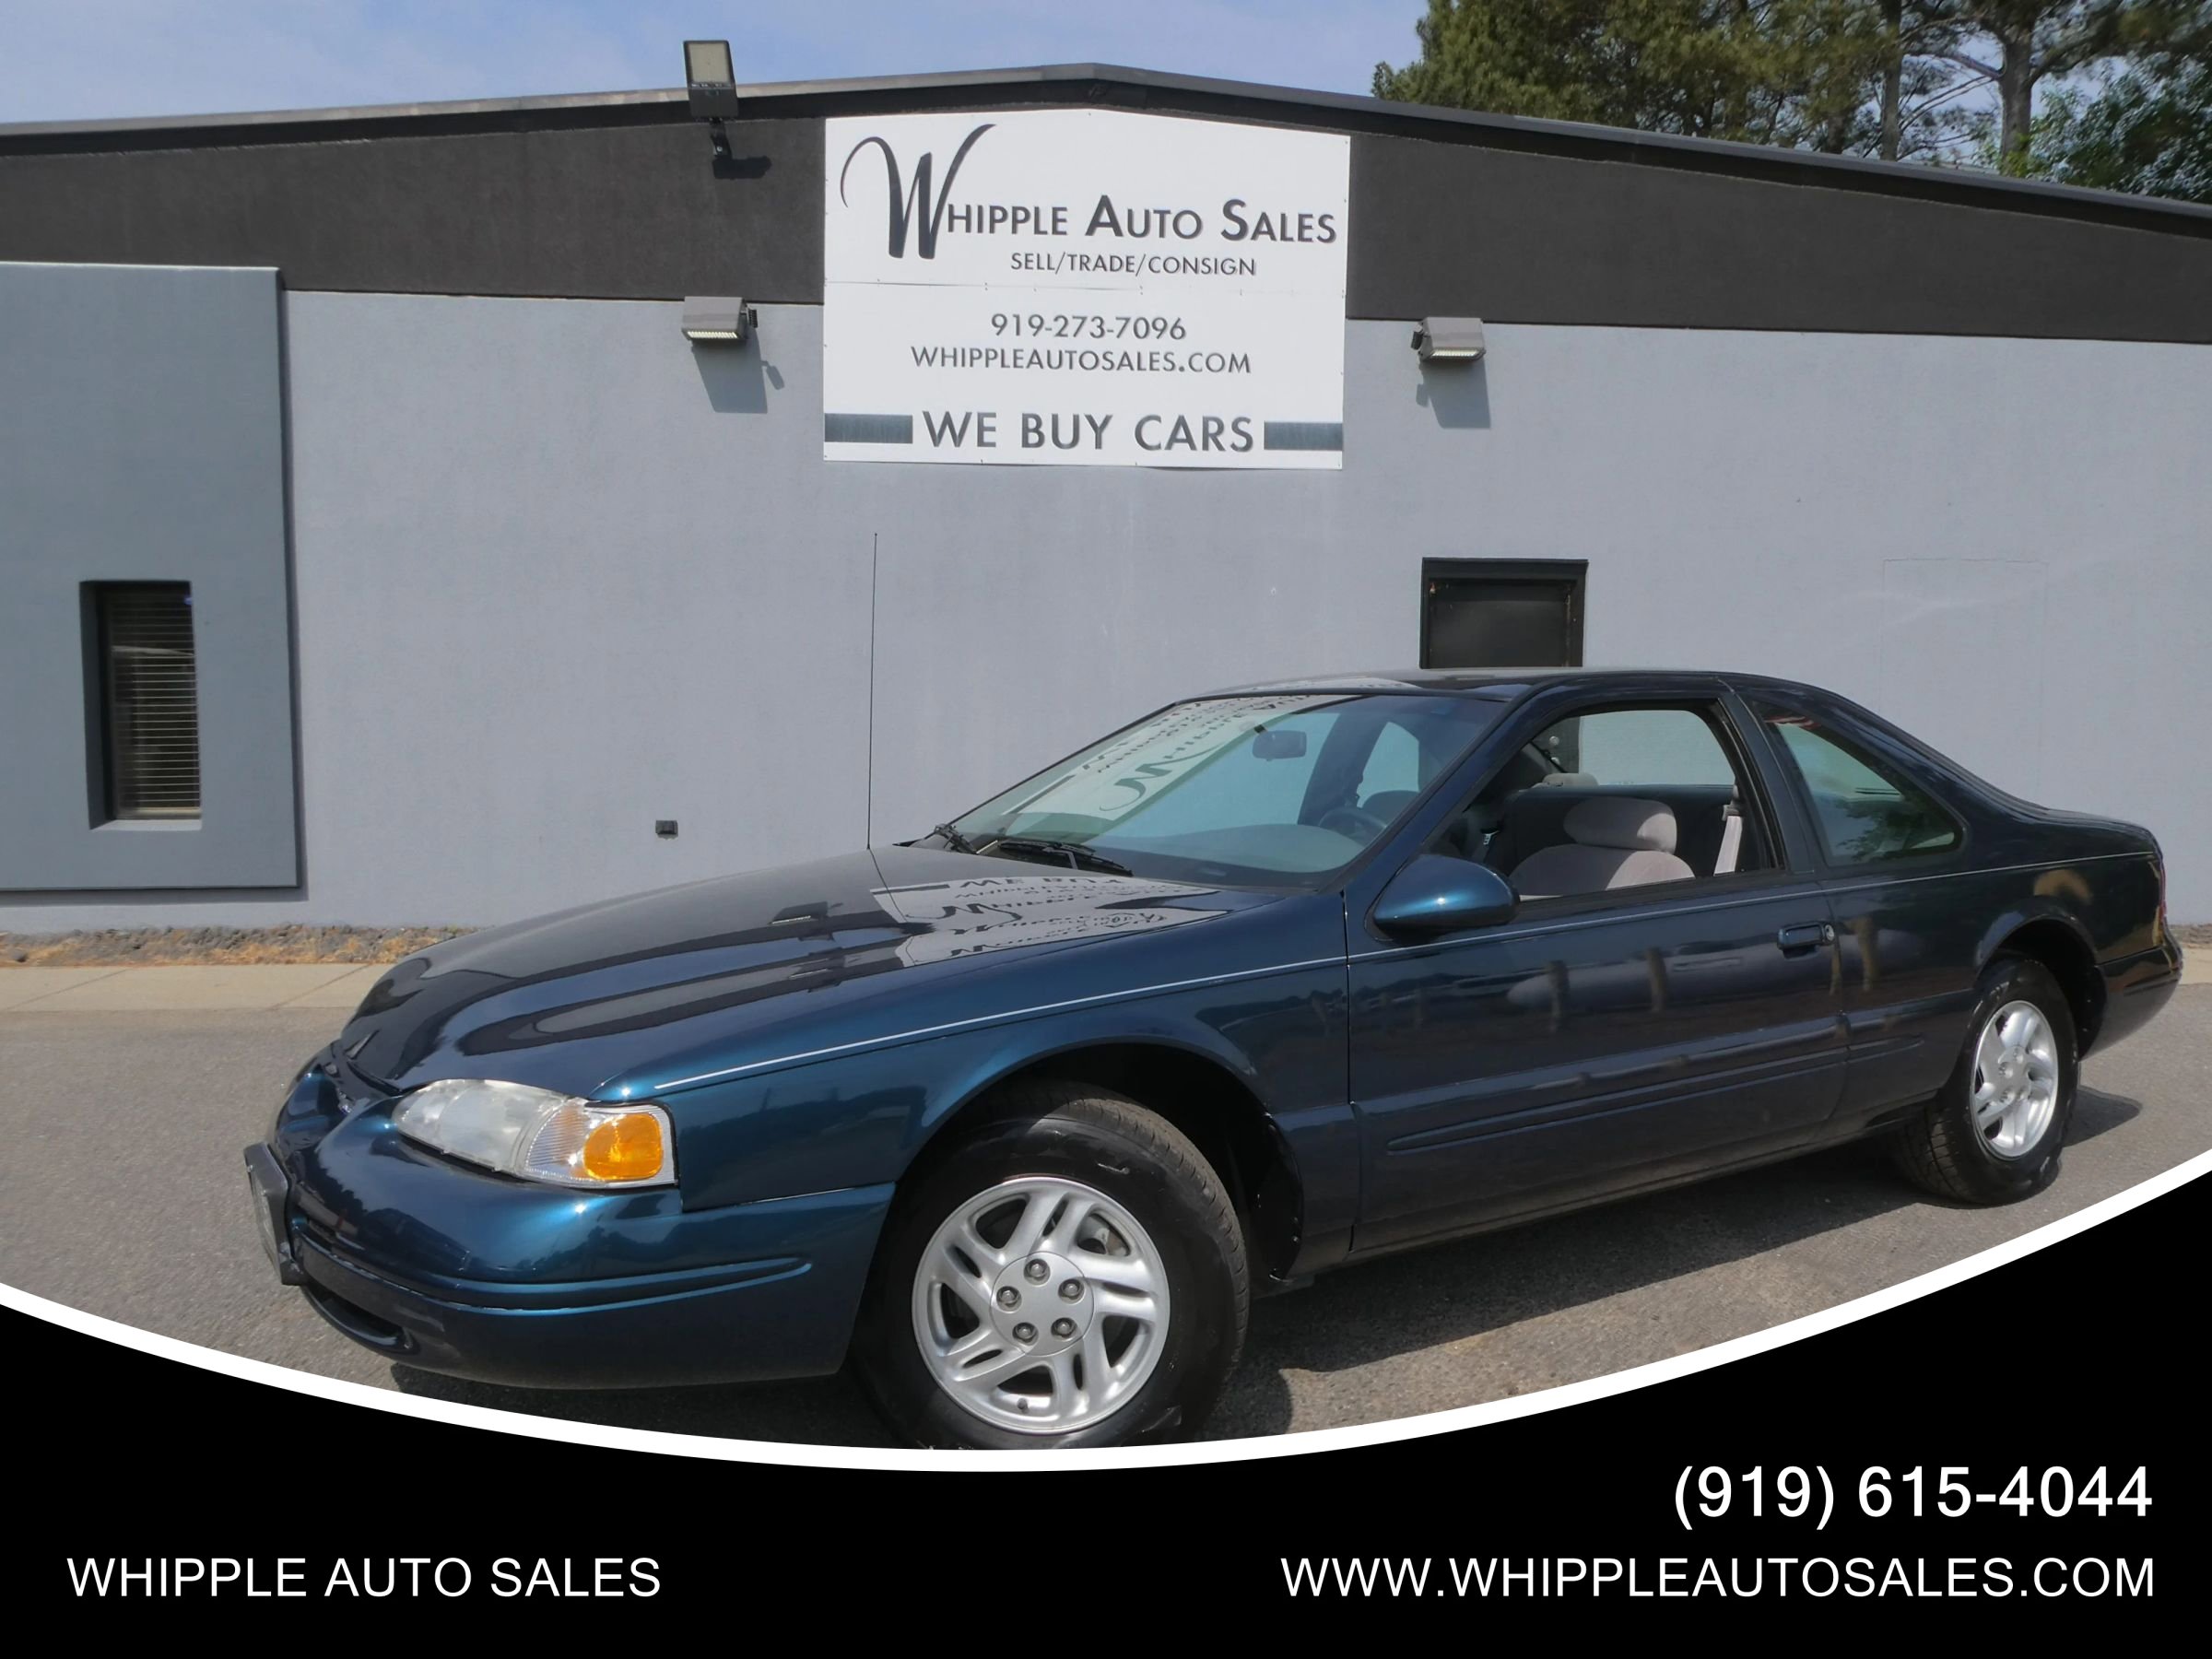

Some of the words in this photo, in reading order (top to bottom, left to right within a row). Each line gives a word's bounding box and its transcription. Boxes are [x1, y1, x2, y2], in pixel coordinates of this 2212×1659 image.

[840, 124, 1068, 259] WHIPPLE
[1085, 194, 1202, 241] AUTO
[1220, 199, 1337, 243] SALES
[1010, 253, 1256, 276] SELL/TRADE/CONSIGN
[990, 313, 1186, 340] 919-273-7096
[911, 347, 1252, 374] WHIPPLEAUTOSALES.COM
[923, 411, 997, 449] WE
[1020, 413, 1113, 450] BUY
[1135, 415, 1254, 453] CARS
